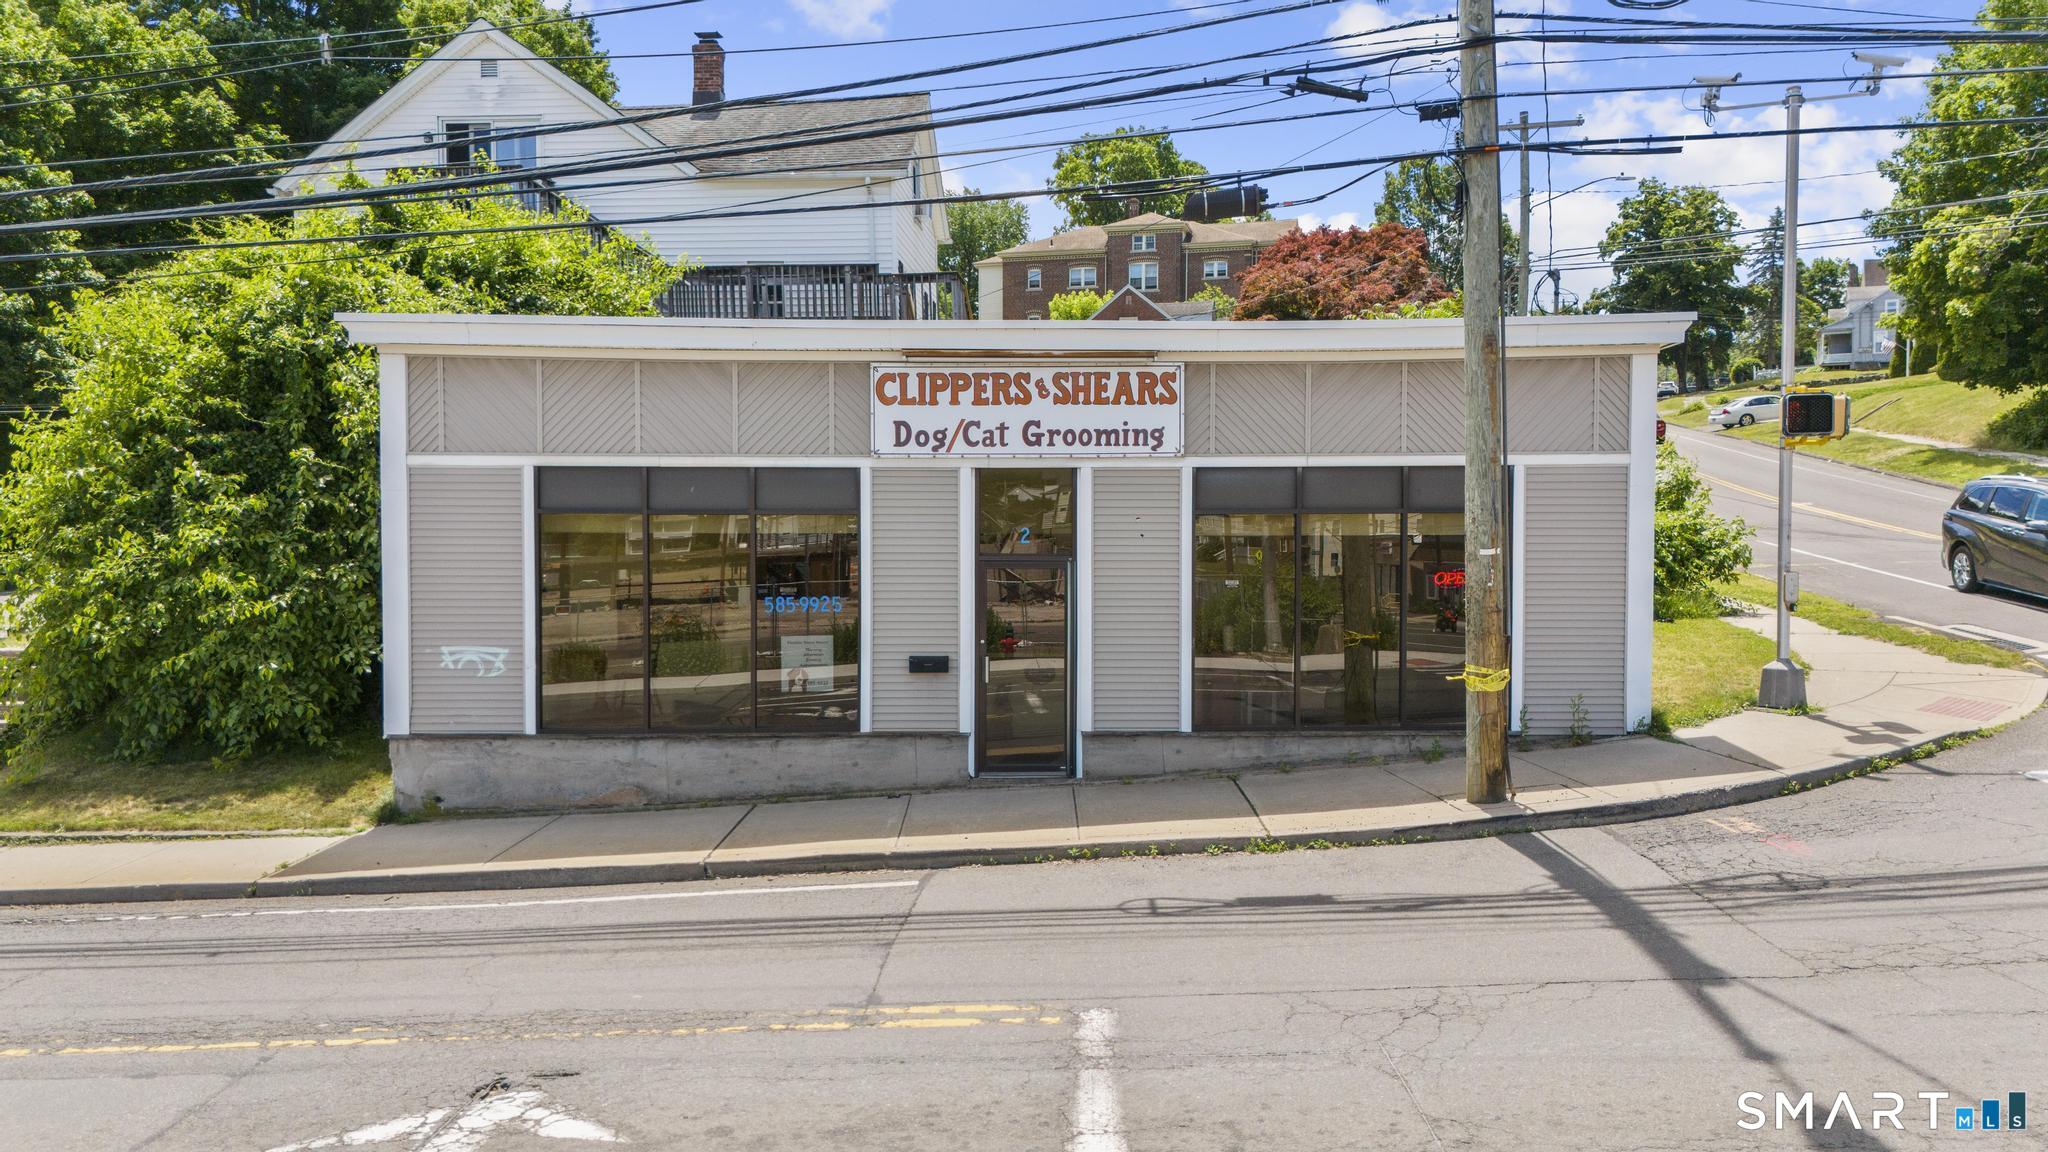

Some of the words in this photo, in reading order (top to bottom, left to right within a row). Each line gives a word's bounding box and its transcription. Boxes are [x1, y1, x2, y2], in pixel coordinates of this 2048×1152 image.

[875, 371, 1032, 406] CLIPPERS
[1034, 377, 1051, 399] &
[1052, 371, 1178, 406] SHEARS
[892, 418, 1010, 453] Dog/Cat
[1021, 419, 1165, 451] Grooming
[1433, 571, 1466, 586] OPE
[764, 595, 842, 614] 585-9925
